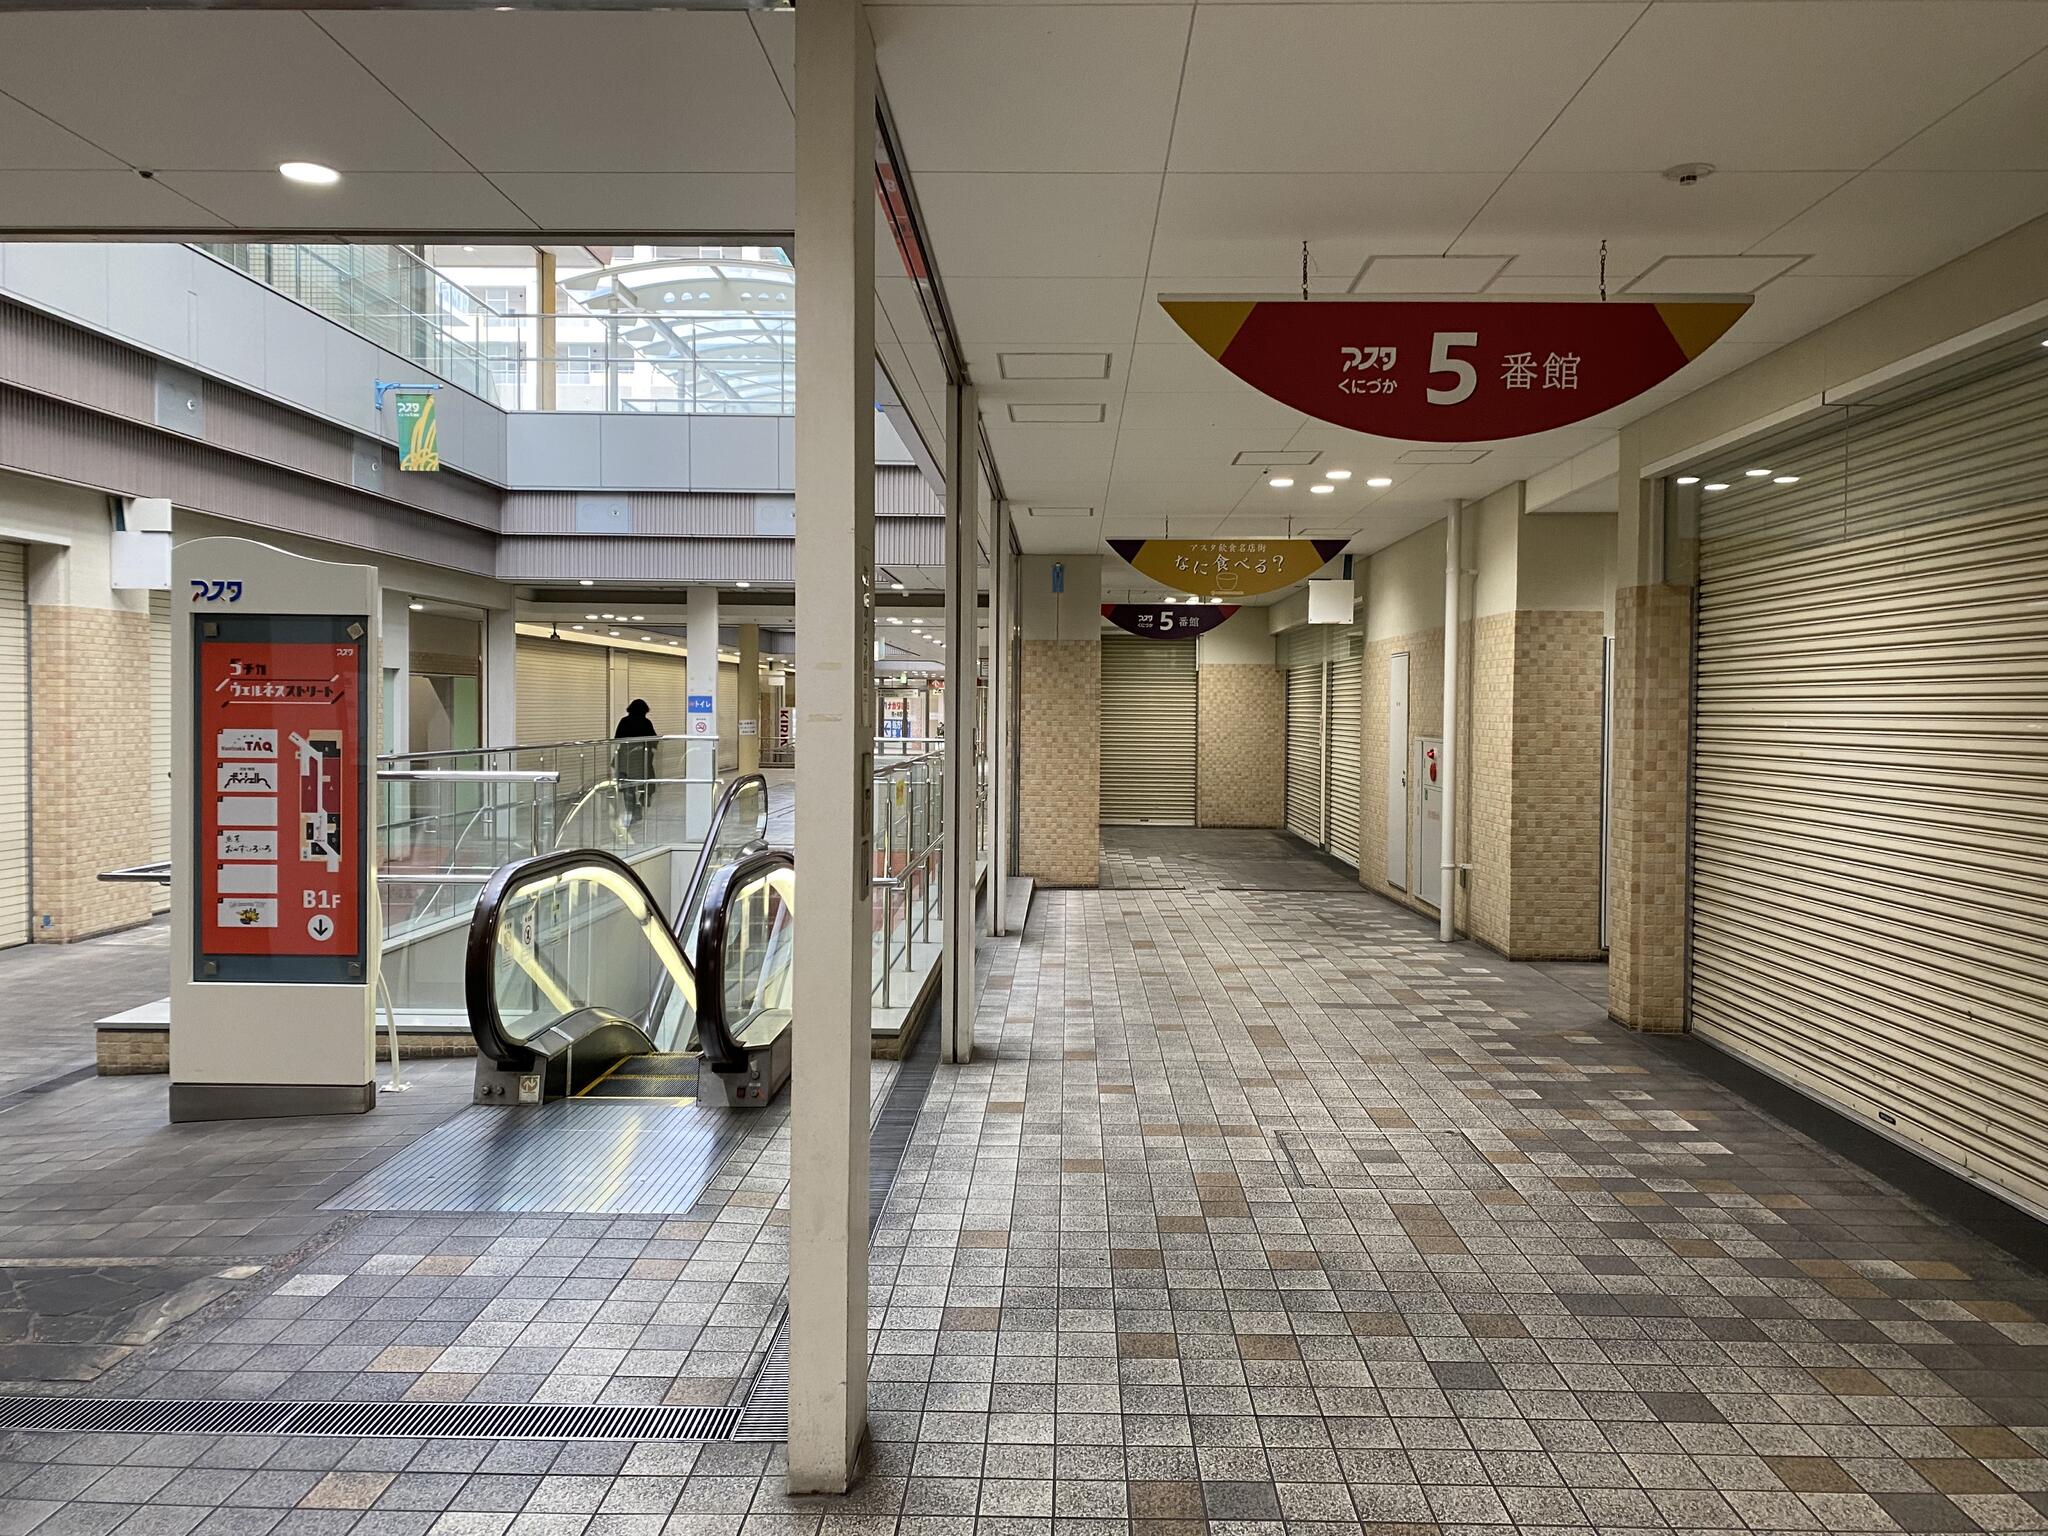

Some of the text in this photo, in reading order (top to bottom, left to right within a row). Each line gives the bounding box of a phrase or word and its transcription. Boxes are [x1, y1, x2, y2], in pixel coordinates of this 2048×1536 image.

[1341, 332, 1581, 406] アスタ 5 番館
[1338, 378, 1398, 394] くにづか
[191, 580, 243, 602] アスタ
[1160, 611, 1174, 631] 5
[1178, 616, 1200, 627] 番館
[229, 682, 334, 697] ウェルネスストリート
[695, 700, 711, 708] トイレ
[303, 889, 341, 909] B1F
